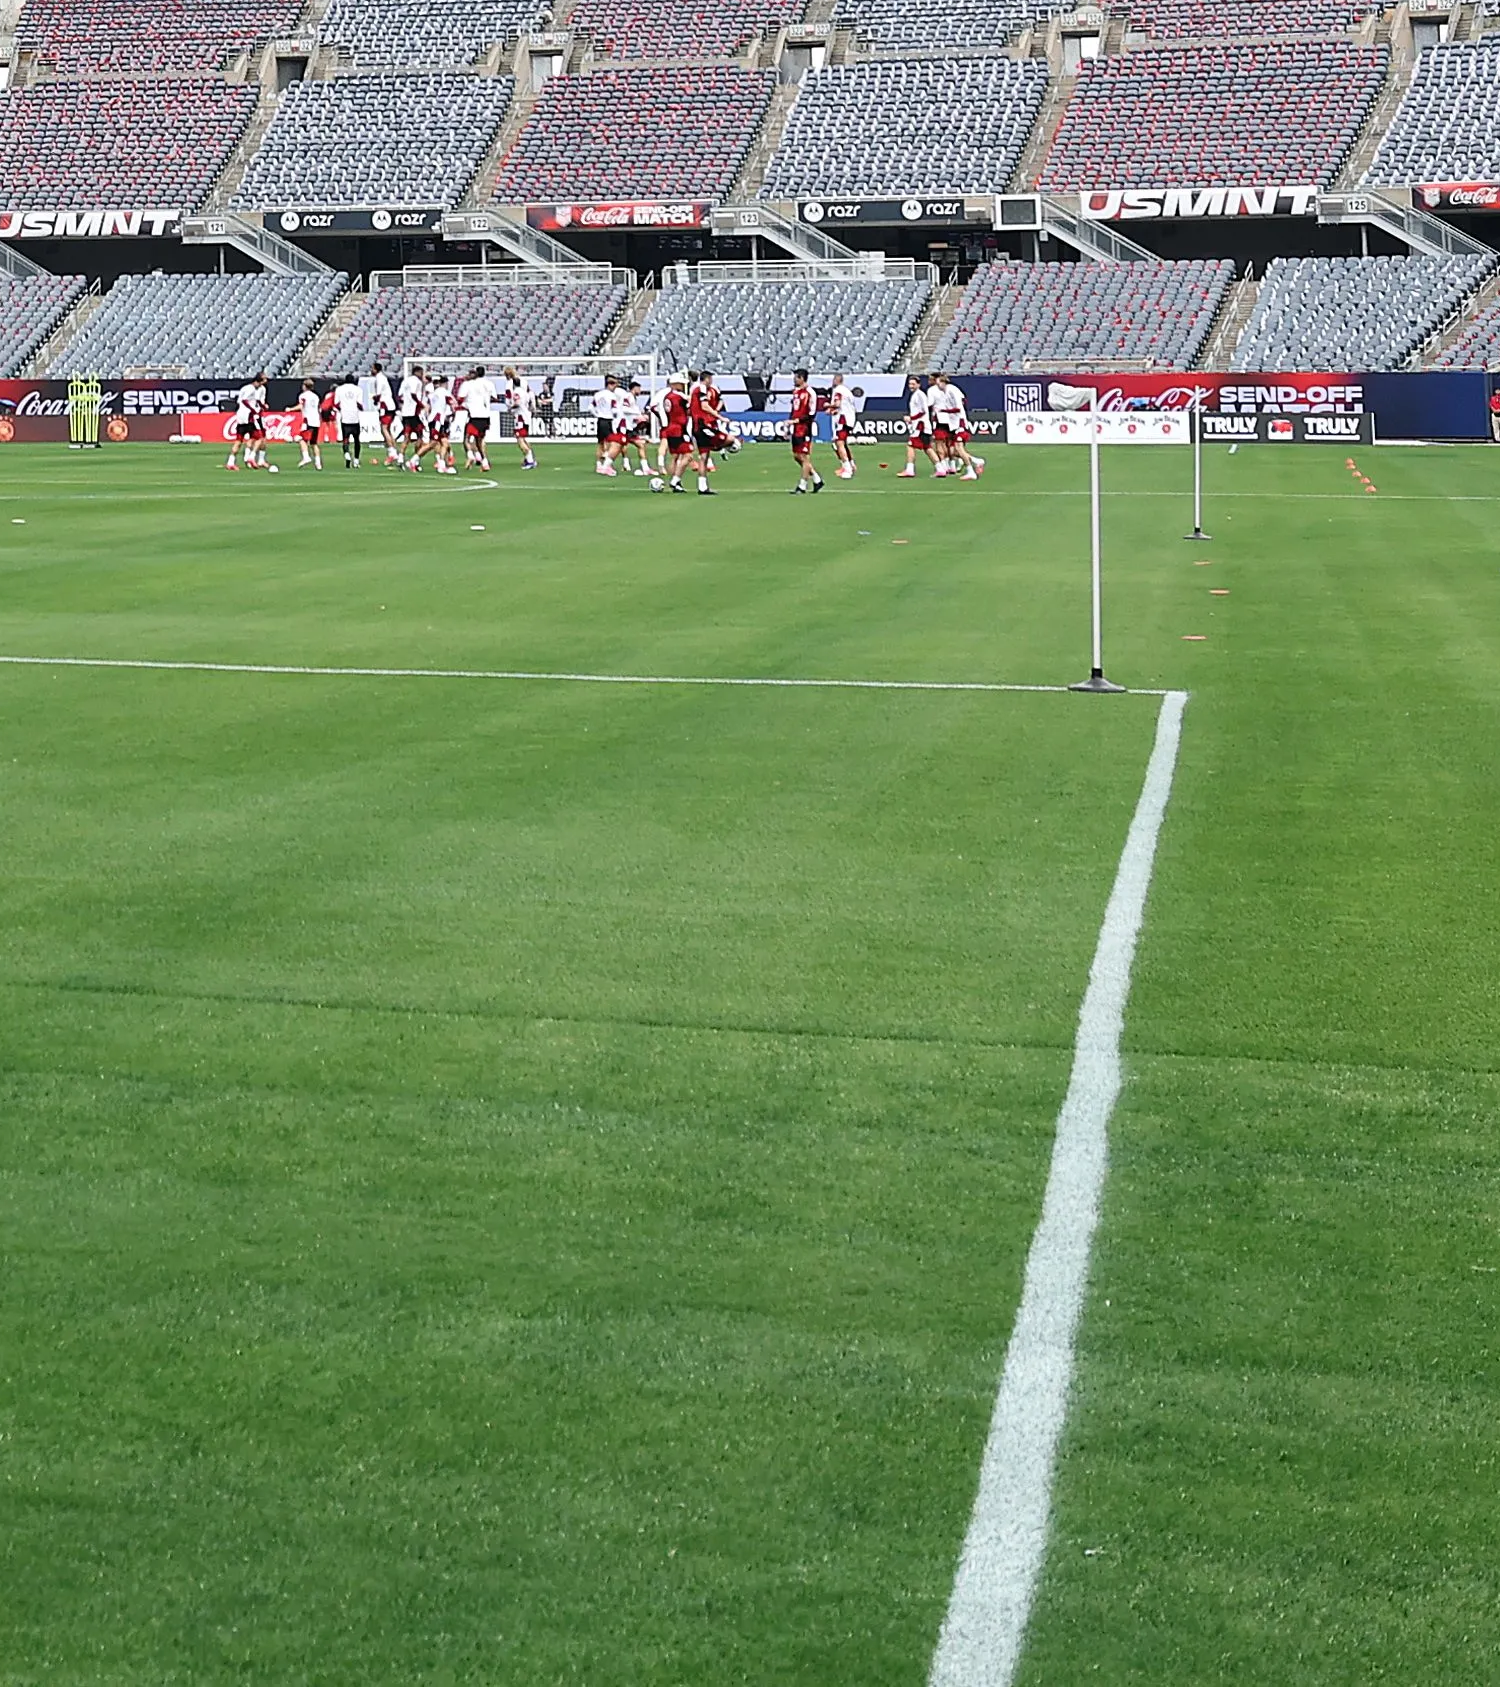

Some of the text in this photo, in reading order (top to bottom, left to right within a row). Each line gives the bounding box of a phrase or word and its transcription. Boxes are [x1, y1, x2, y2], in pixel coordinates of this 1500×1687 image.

[1411, 0, 1426, 11] 324
[1080, 186, 1315, 219] USMNT
[1449, 188, 1497, 205] Coca-Cola
[633, 205, 693, 213] SEND-OFF
[827, 205, 860, 218] razr
[926, 202, 960, 216] razr
[1349, 200, 1366, 211] 125
[303, 213, 335, 226] razr
[394, 213, 427, 226] razr
[580, 207, 629, 225] Coca-Cola
[633, 213, 693, 224] MATCH
[742, 214, 757, 223] 123
[211, 223, 224, 232] 121
[472, 219, 487, 228] 122
[1007, 386, 1039, 405] USA
[1220, 386, 1363, 402] SEND-OFF
[1203, 416, 1258, 433] TRULY
[1304, 416, 1360, 433] TRULY
